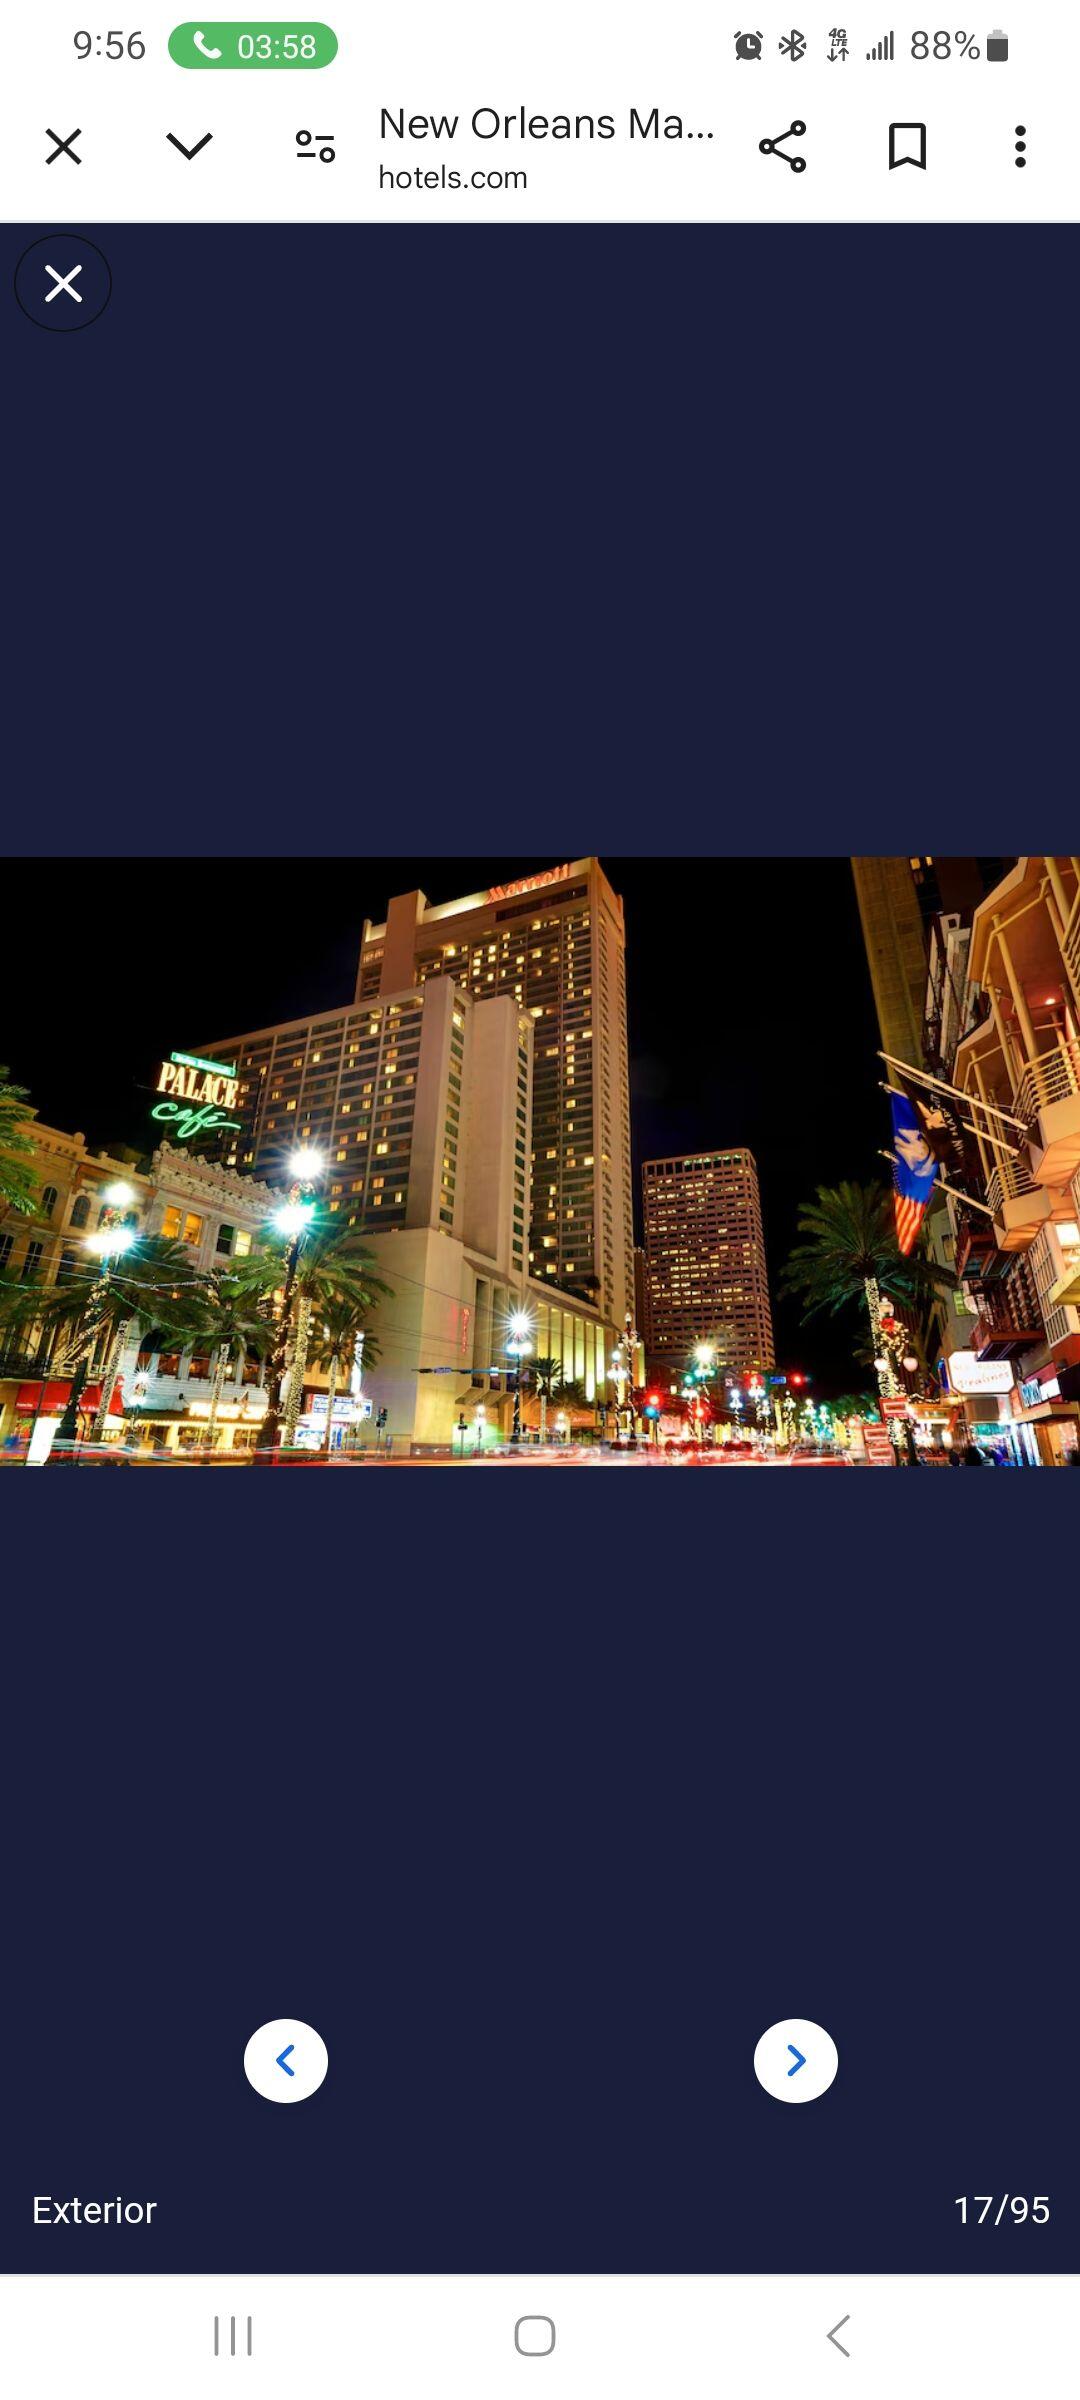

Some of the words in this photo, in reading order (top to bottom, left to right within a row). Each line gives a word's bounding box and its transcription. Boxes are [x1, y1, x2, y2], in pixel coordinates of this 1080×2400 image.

[73, 31, 146, 61] 9:56
[237, 34, 317, 60] 03:58
[828, 27, 847, 38] 4G
[831, 38, 848, 46] LTE
[910, 30, 981, 60] 88%
[380, 107, 460, 140] New
[471, 105, 616, 140] Orleans
[379, 163, 528, 190] hotels.com
[157, 1061, 239, 1109] PALACE
[33, 2196, 158, 2224] Exterior
[954, 2193, 1050, 2226] 17/95
